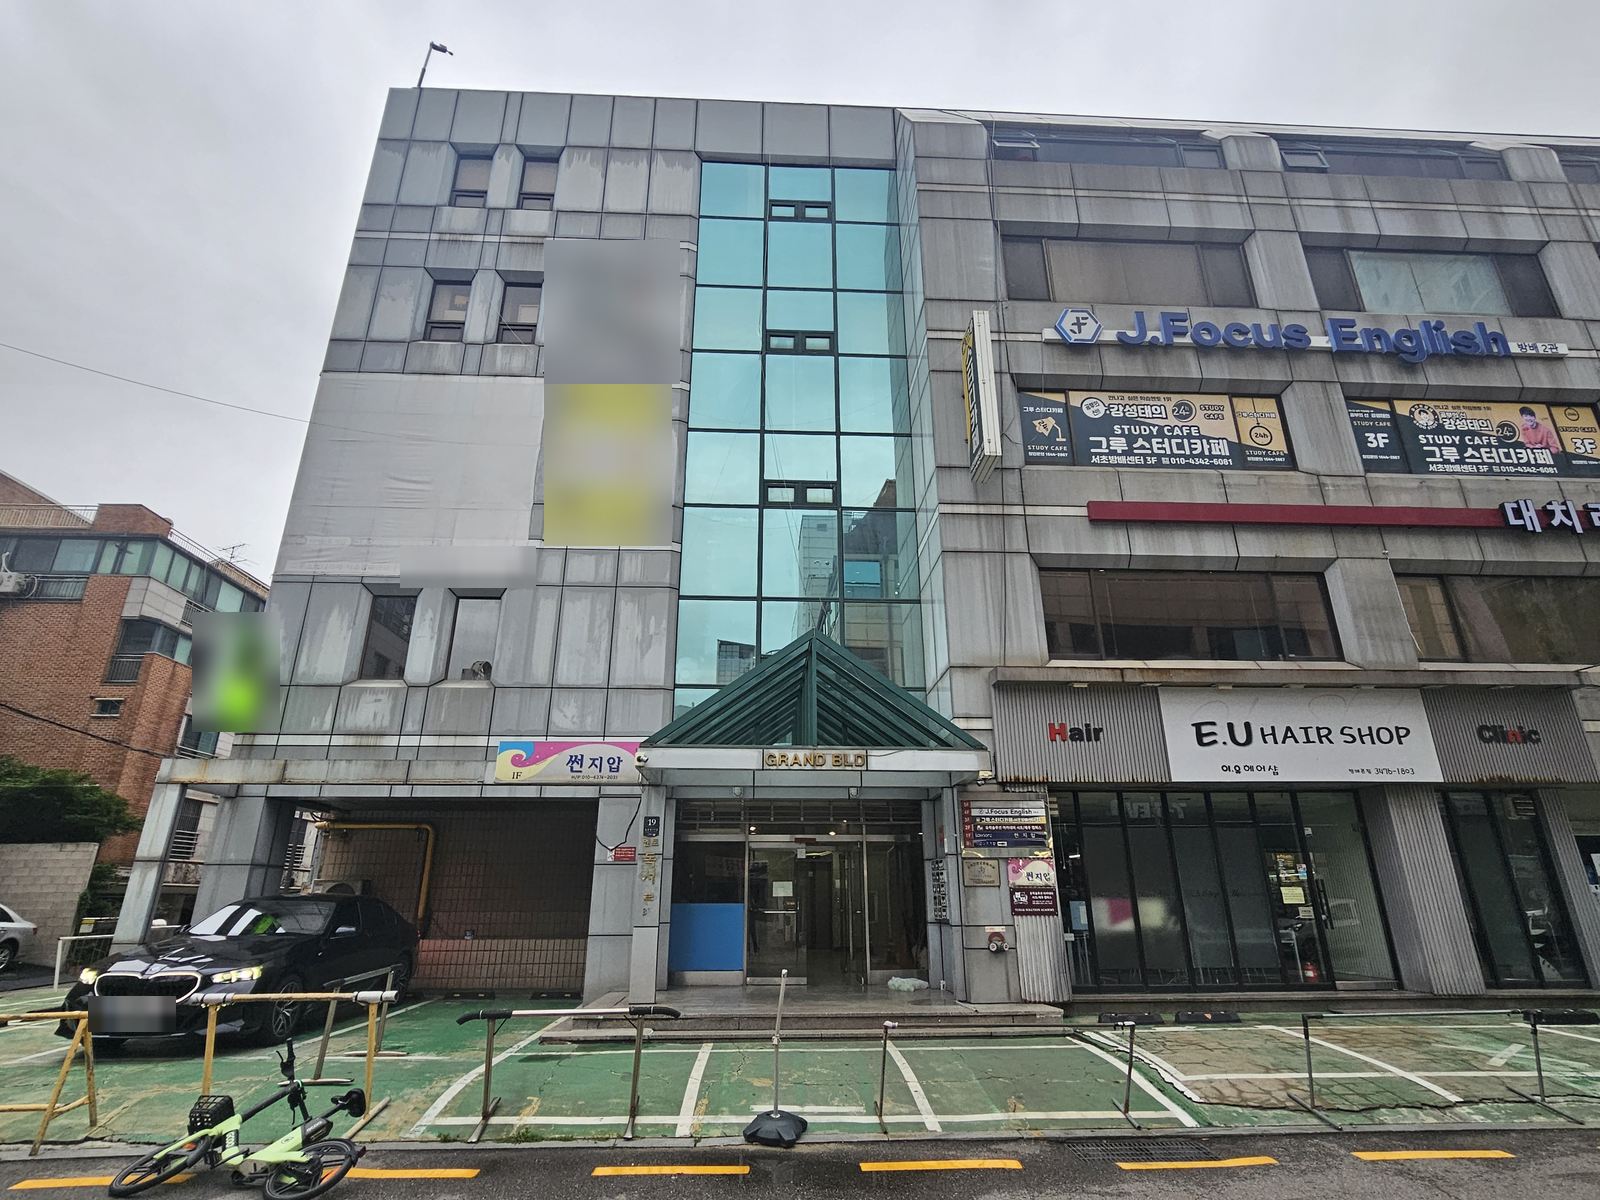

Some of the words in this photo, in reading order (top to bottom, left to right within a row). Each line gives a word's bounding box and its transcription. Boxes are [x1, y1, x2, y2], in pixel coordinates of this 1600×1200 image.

[1116, 311, 1311, 350] J.Focus
[1328, 318, 1511, 363] English
[1516, 342, 1539, 353] 방배
[1541, 343, 1559, 353] 2관
[1108, 404, 1167, 419] 강성태의
[1204, 412, 1224, 420] CAFE
[1113, 425, 1158, 435] STUDY
[1163, 426, 1200, 436] CAFE
[1443, 418, 1494, 432] 강성태의
[1089, 437, 1128, 453] 그루
[1132, 437, 1230, 455] 스터디카페
[1364, 432, 1390, 448] 3F
[1418, 434, 1460, 444] STUDY
[1464, 436, 1499, 445] CAFE
[1571, 438, 1597, 454] 3F
[1091, 455, 1145, 465] 서초방배센터
[1146, 456, 1158, 464] 3F
[1170, 457, 1233, 466] 010-4342-6081
[1422, 446, 1461, 462] 그루
[1463, 447, 1555, 465] 스터디카페
[1428, 463, 1478, 473] 서초방배센터
[1048, 722, 1104, 742] Hair
[1191, 721, 1253, 747] E.U
[1260, 725, 1335, 745] HAIR
[1340, 725, 1411, 745] SHOP
[1477, 724, 1542, 744] Clinic
[765, 752, 827, 767] GRAND
[832, 752, 866, 768] BLD
[1374, 767, 1415, 776] 3476-1803
